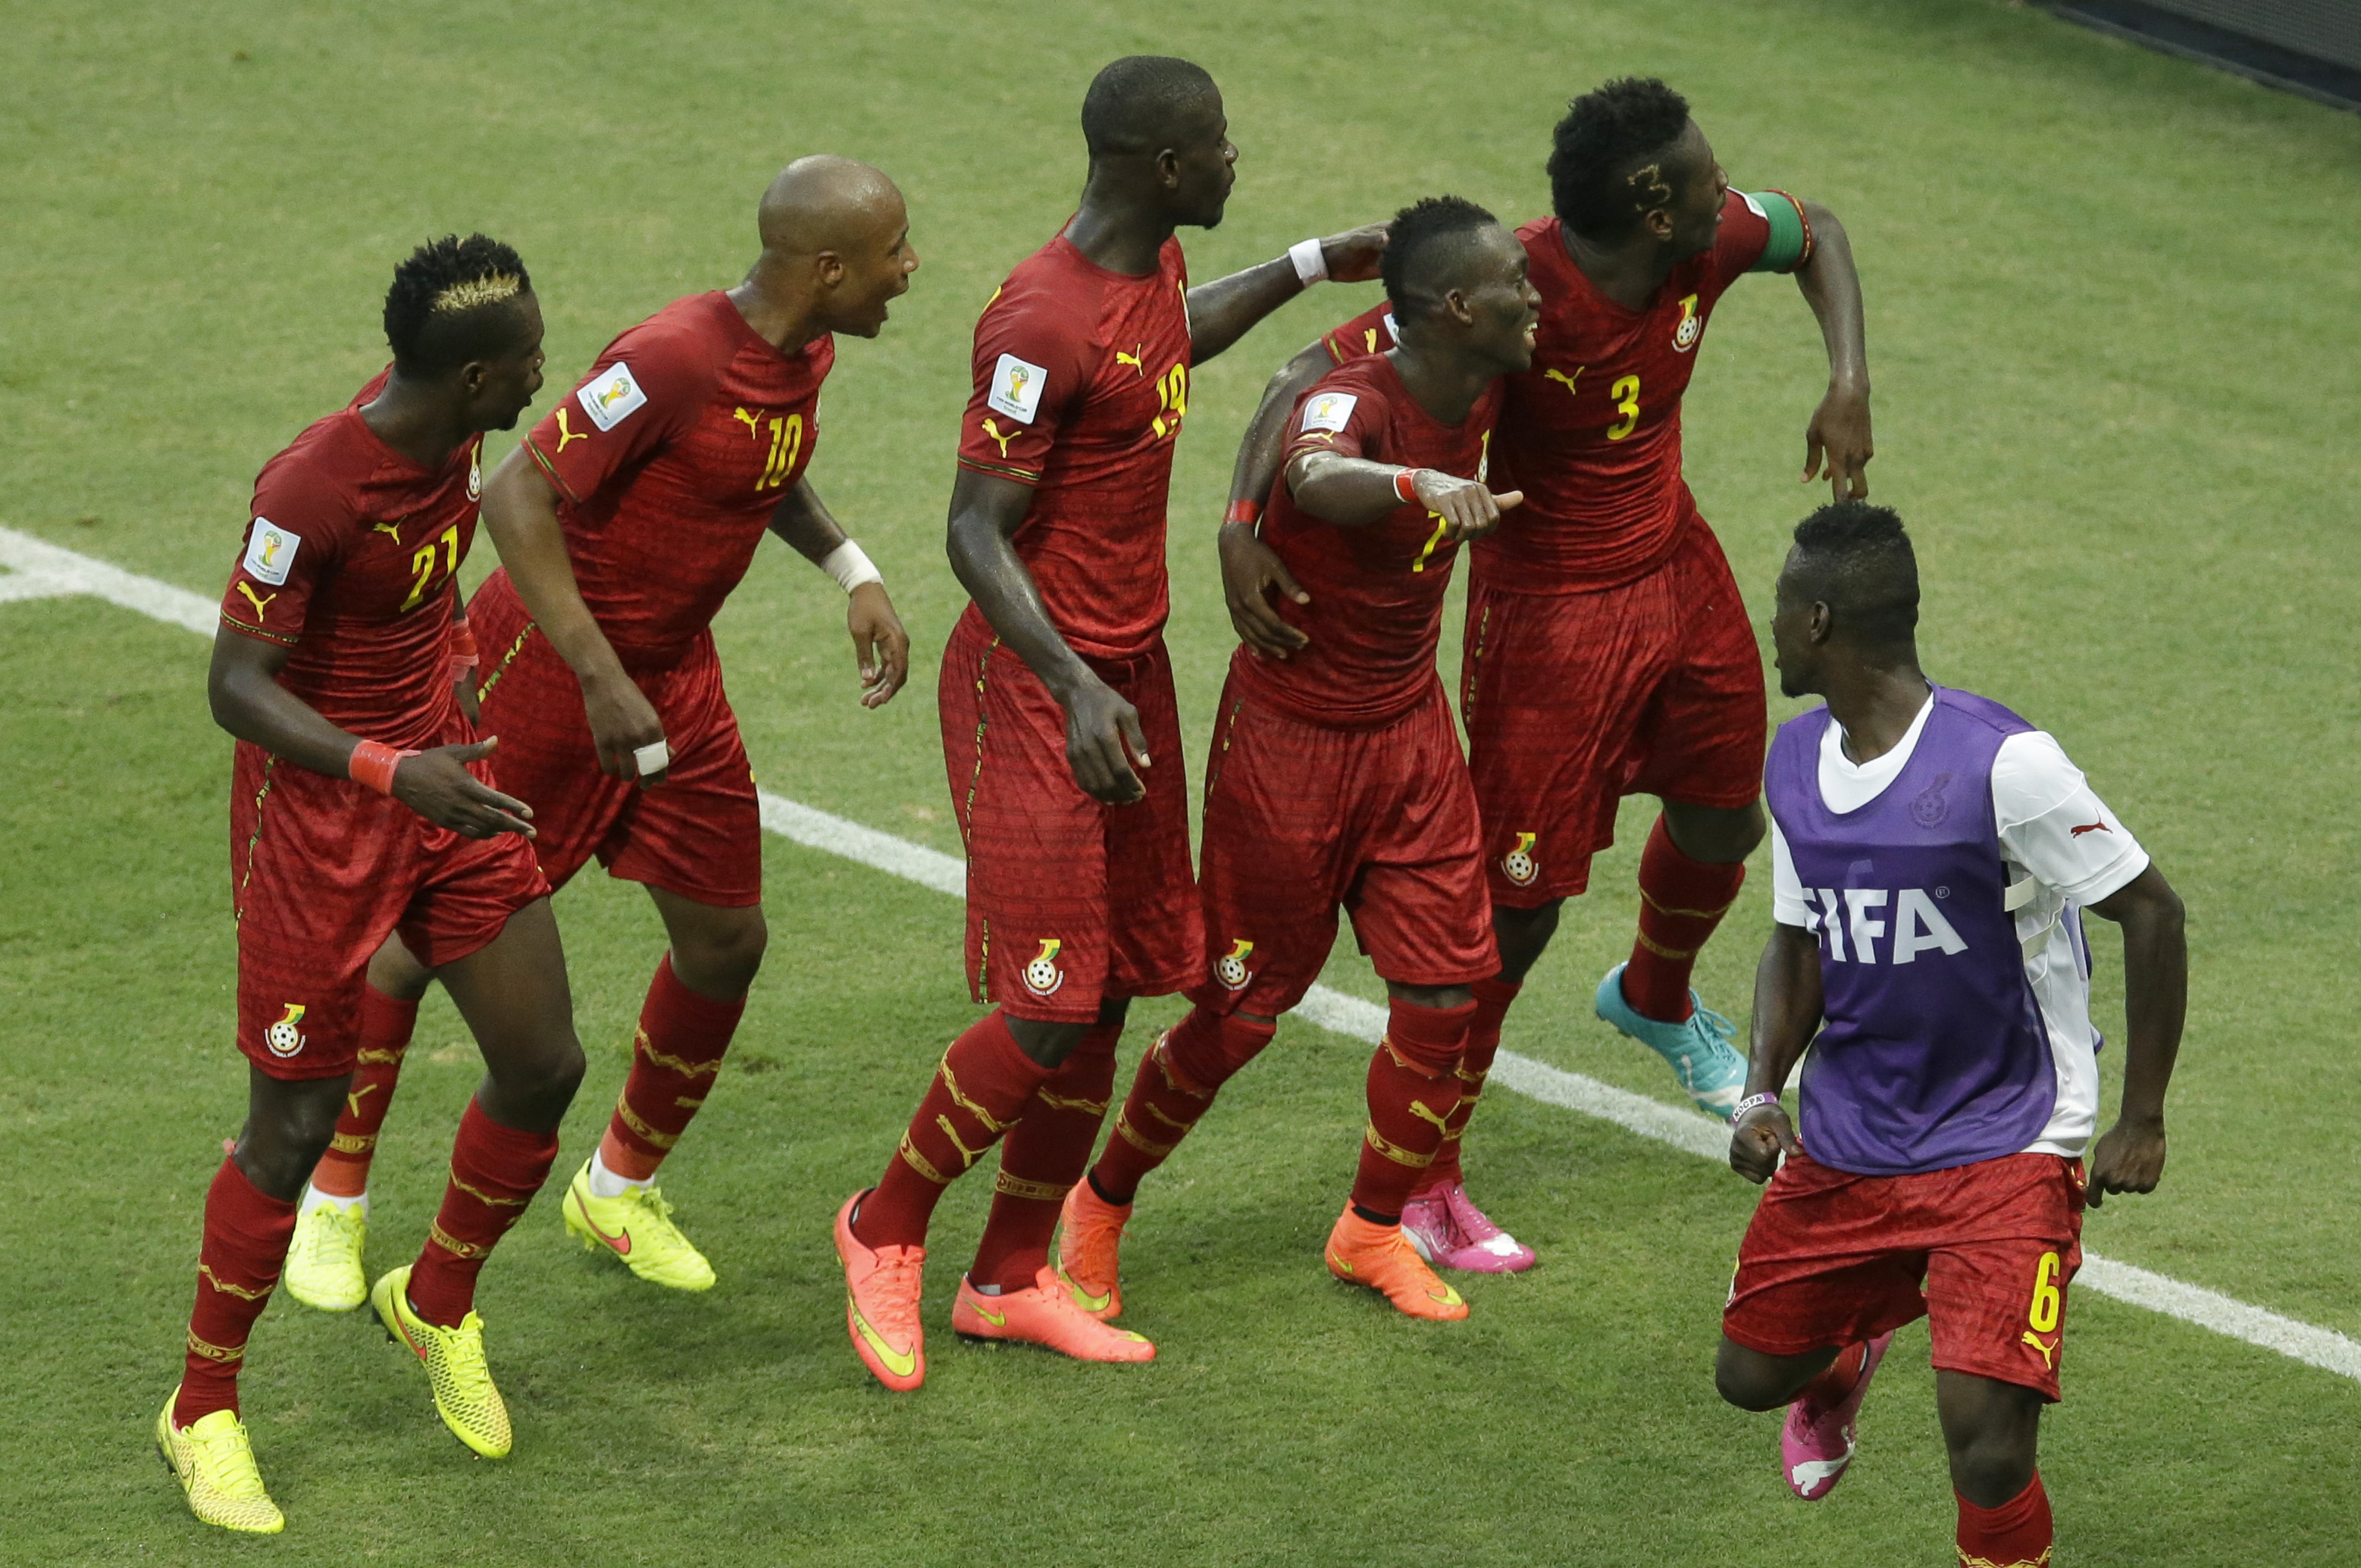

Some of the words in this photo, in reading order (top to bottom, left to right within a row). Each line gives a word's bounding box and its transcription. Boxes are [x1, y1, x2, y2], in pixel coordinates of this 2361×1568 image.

[1152, 362, 1187, 440] 19
[1607, 374, 1640, 441] 3
[755, 413, 803, 491] 10
[400, 524, 458, 612] 21
[1413, 510, 1447, 572] 7
[2029, 1251, 2060, 1333] 6
